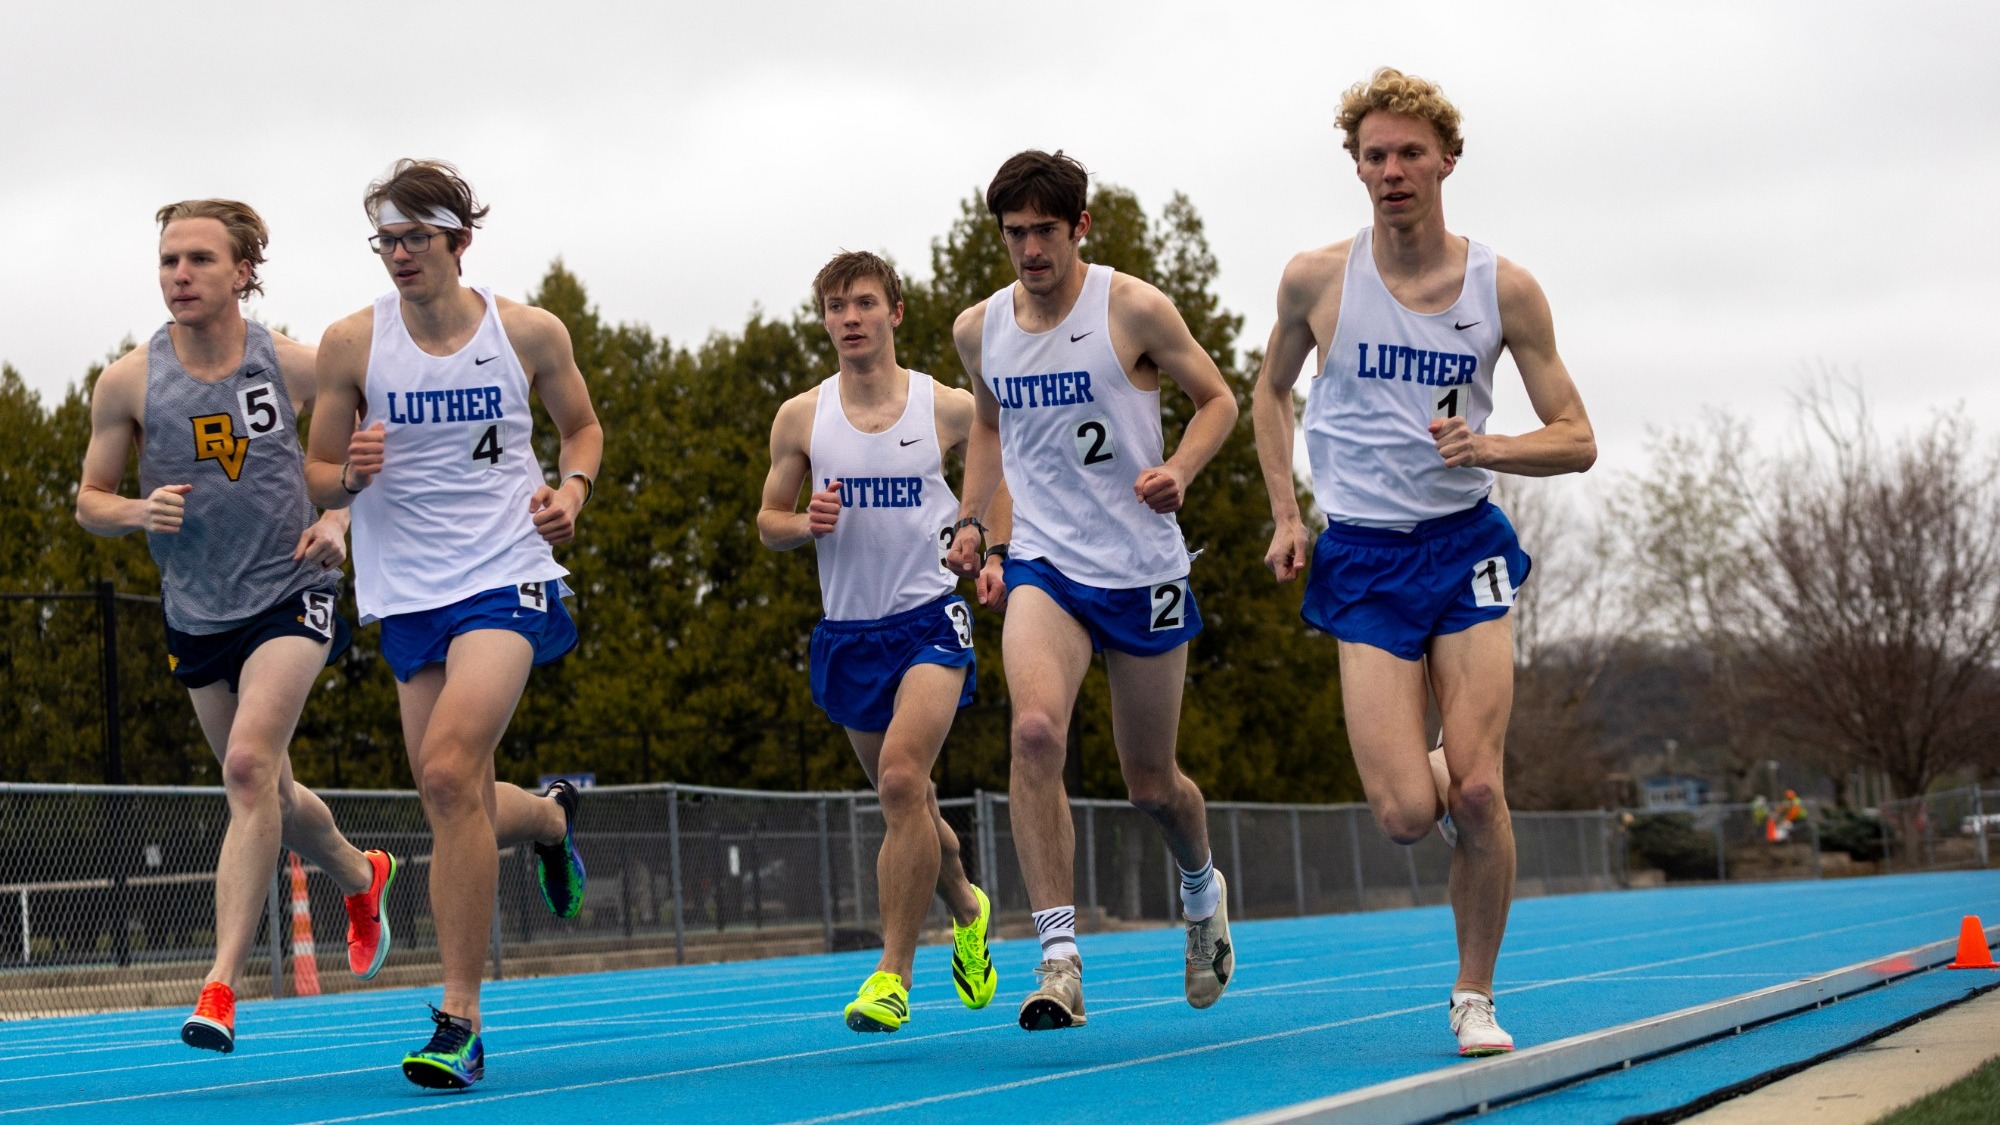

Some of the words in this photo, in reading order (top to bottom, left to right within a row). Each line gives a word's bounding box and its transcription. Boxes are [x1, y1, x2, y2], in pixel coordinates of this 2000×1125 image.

[1358, 343, 1478, 387] LUTHER
[245, 387, 277, 433] 5
[387, 386, 503, 424] LUTHER
[993, 371, 1095, 409] LUTHER
[1437, 388, 1459, 419] 1
[472, 424, 503, 465] 4
[1077, 421, 1114, 466] 2
[520, 582, 544, 608] 4
[1477, 560, 1503, 602] 1
[309, 593, 329, 631] 5
[952, 605, 971, 646] 3
[1153, 583, 1182, 629] 2
